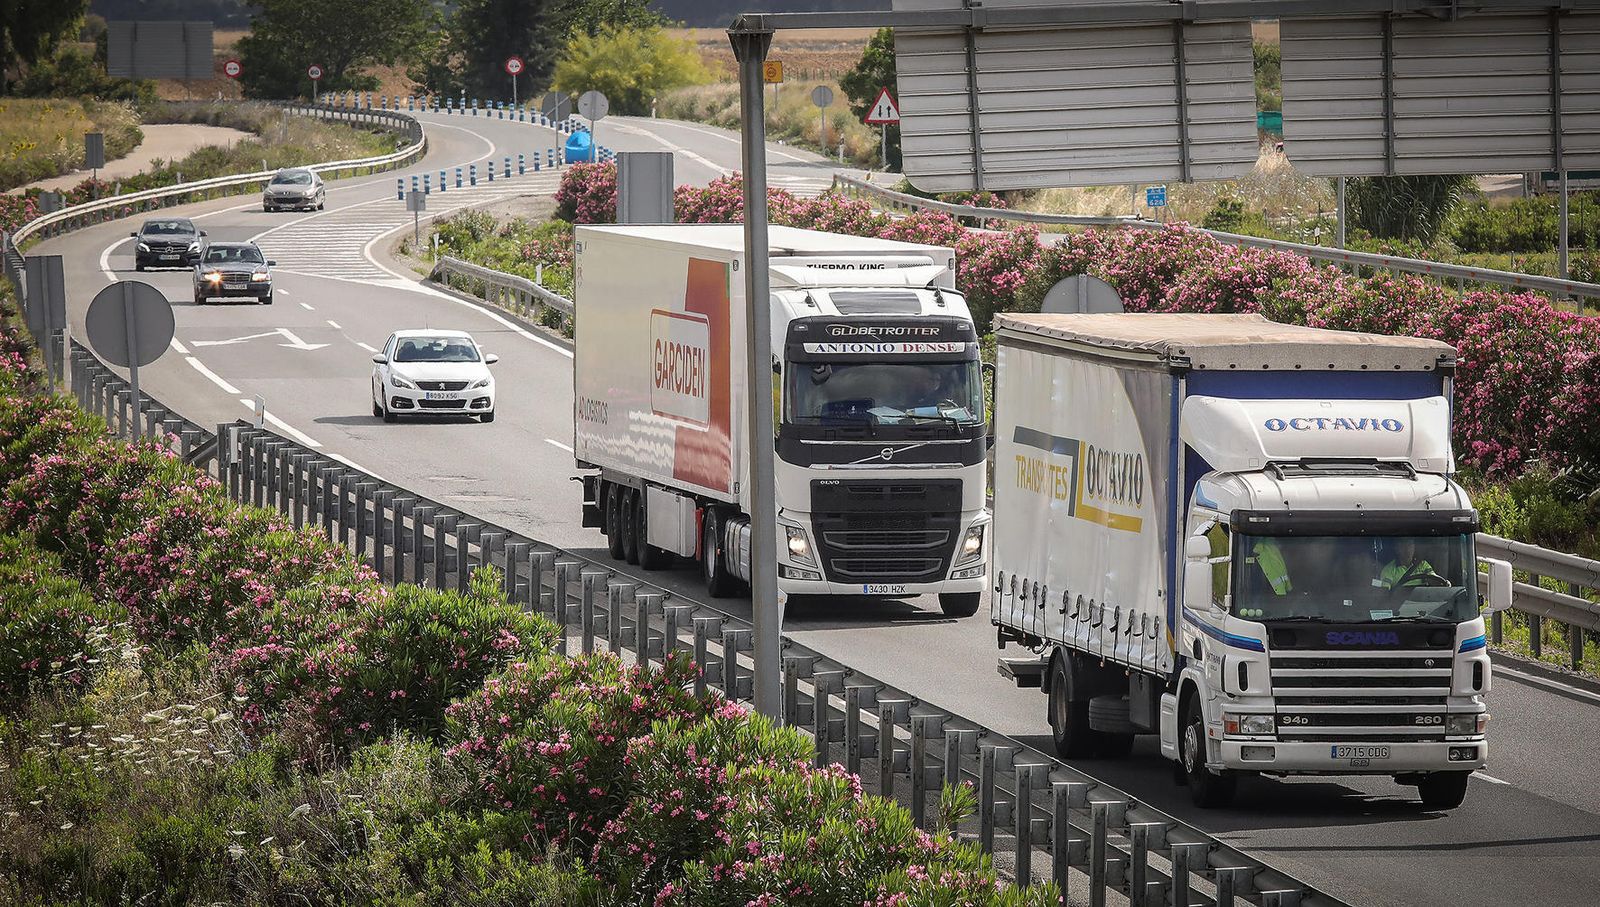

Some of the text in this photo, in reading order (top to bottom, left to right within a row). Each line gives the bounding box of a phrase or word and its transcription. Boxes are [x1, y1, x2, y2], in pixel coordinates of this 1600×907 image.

[831, 325, 940, 336] GLOBETROTTER
[815, 343, 958, 353] ANTONIO DENSE
[654, 338, 706, 399] GARCIDEN
[1264, 417, 1405, 432] OCTAVIO
[1015, 444, 1144, 507] TRANSPTES OCTAVIO
[868, 585, 906, 593] 3430 HZK
[1327, 631, 1400, 645] SCANIA
[1415, 715, 1442, 724] 260
[1338, 747, 1389, 757] 3715 CDG
